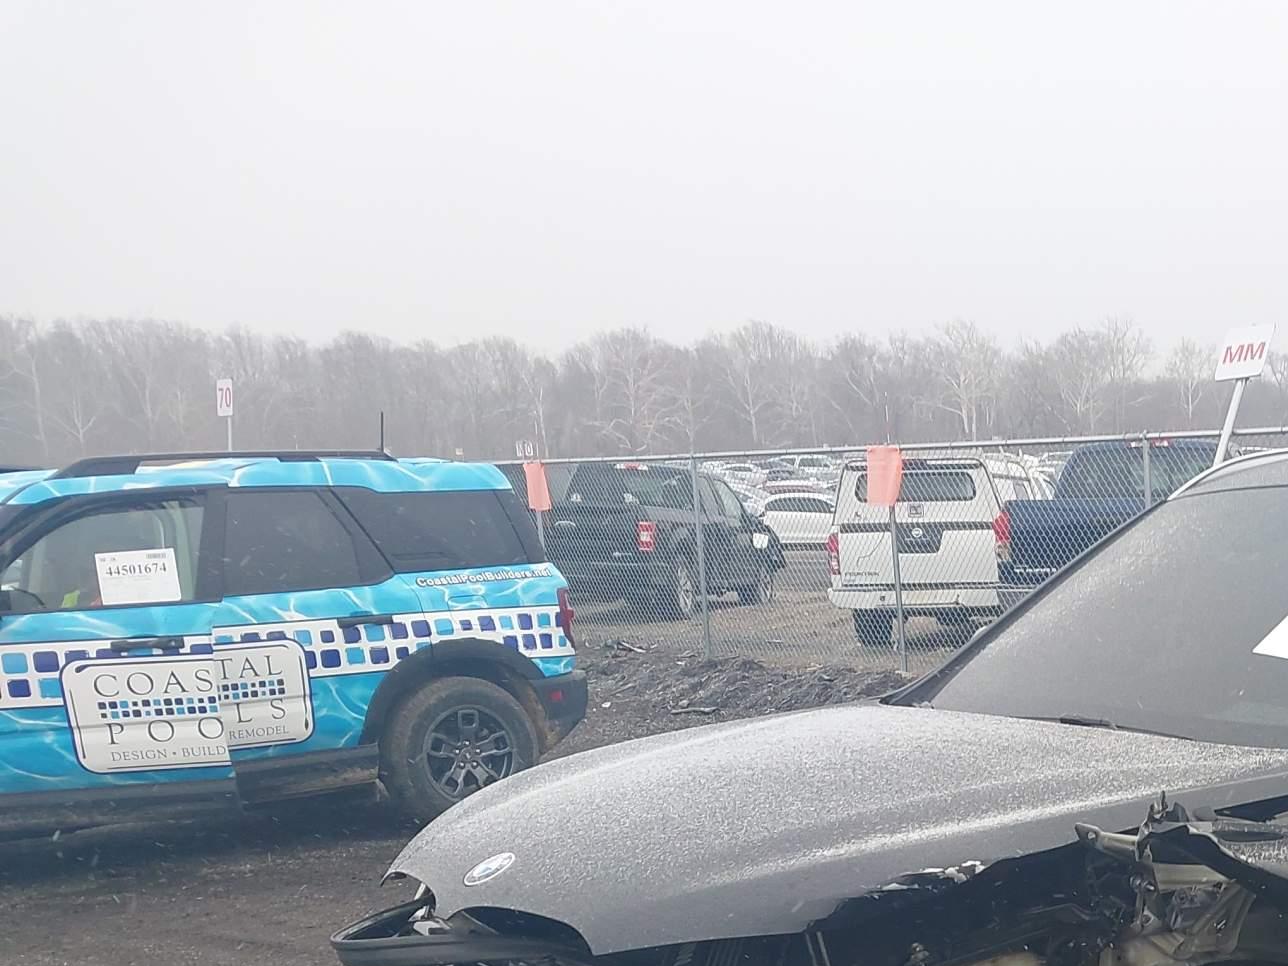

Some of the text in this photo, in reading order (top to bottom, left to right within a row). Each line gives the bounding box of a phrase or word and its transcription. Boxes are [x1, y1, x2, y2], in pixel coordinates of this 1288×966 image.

[1222, 341, 1267, 366] MM
[218, 387, 232, 409] 70
[105, 562, 167, 577] 44501674
[93, 654, 284, 698] COASTAL
[105, 698, 287, 746] POOLS
[111, 724, 290, 762] DESIGN BUILD REMODEL
